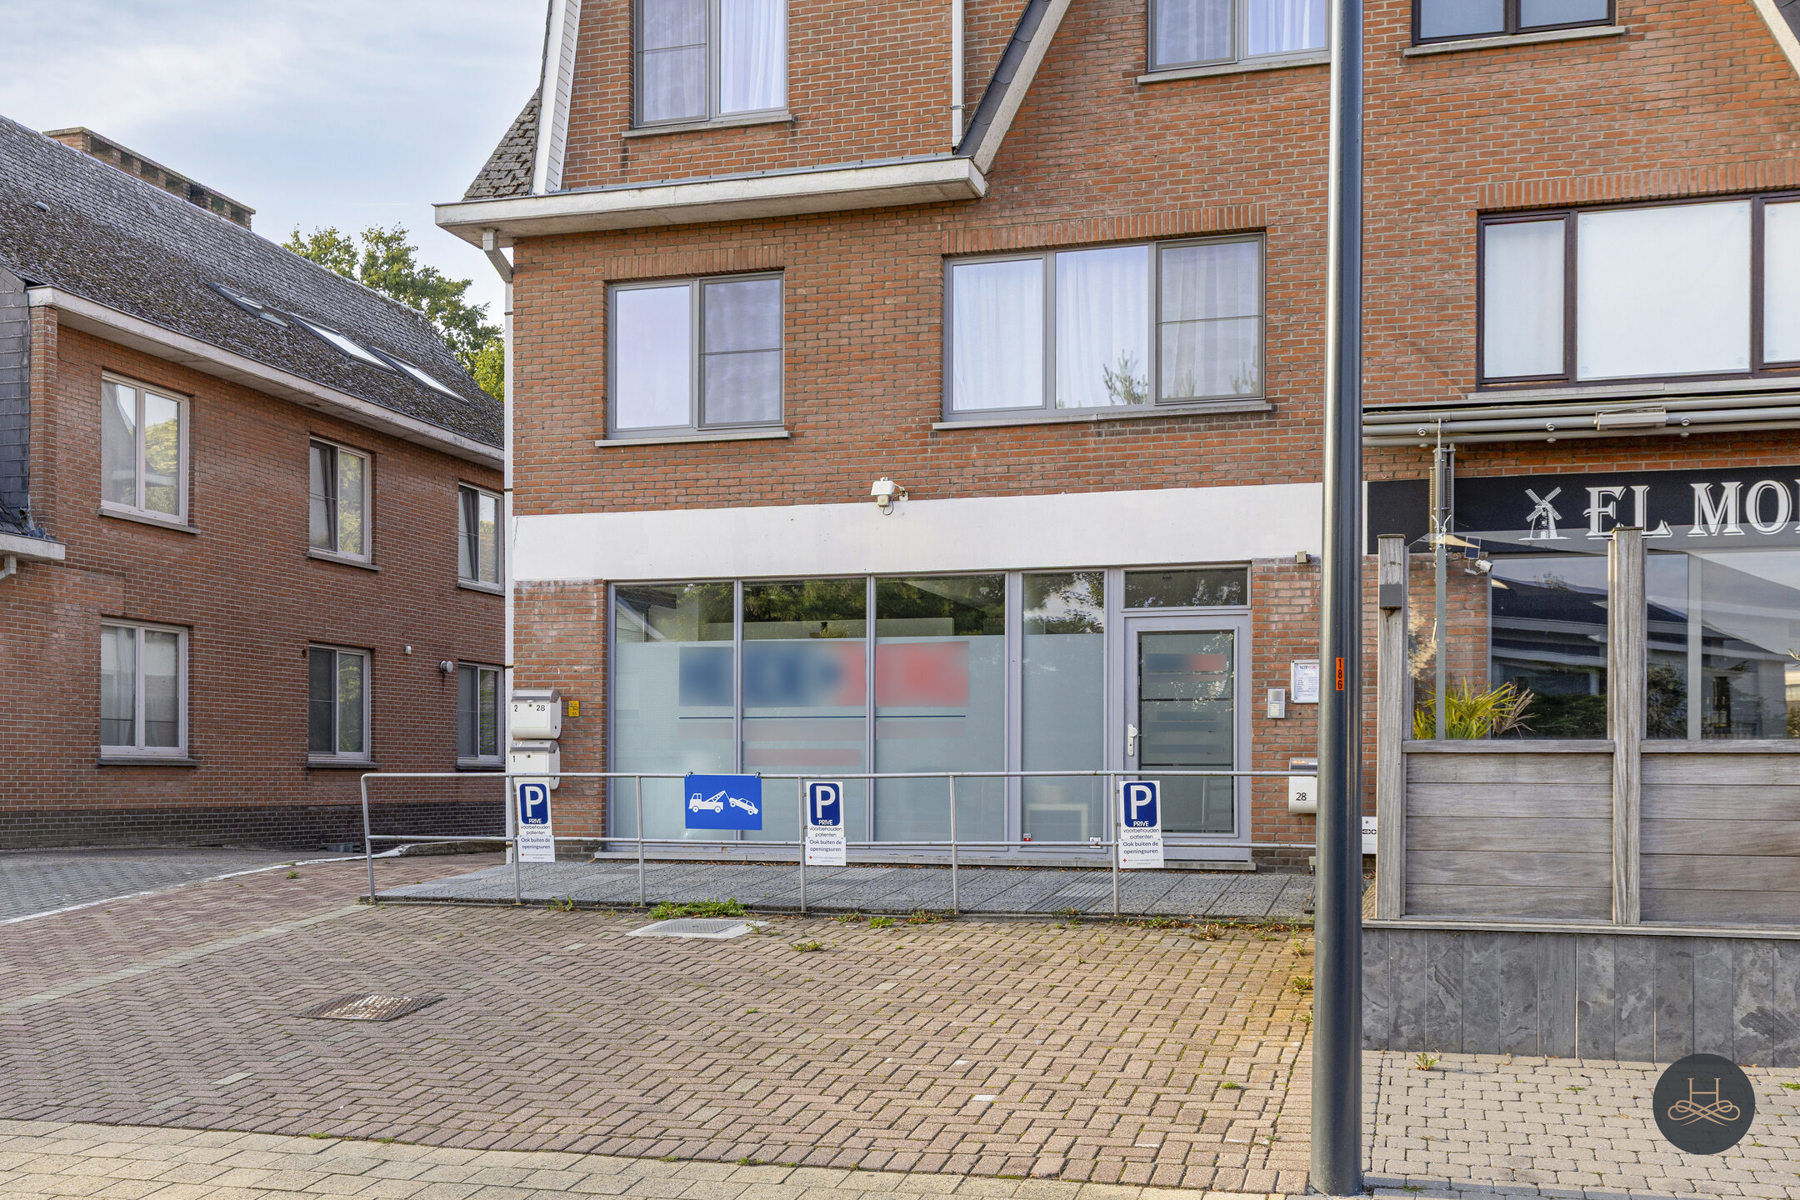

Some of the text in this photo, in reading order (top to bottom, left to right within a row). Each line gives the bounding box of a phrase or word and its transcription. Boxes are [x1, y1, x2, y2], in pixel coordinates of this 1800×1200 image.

[1582, 479, 1800, 540] EL MO
[513, 704, 519, 712] 2
[536, 704, 546, 712] 28
[525, 785, 544, 818] P
[815, 785, 836, 819] P
[1130, 784, 1152, 820] P
[1295, 792, 1307, 801] 28
